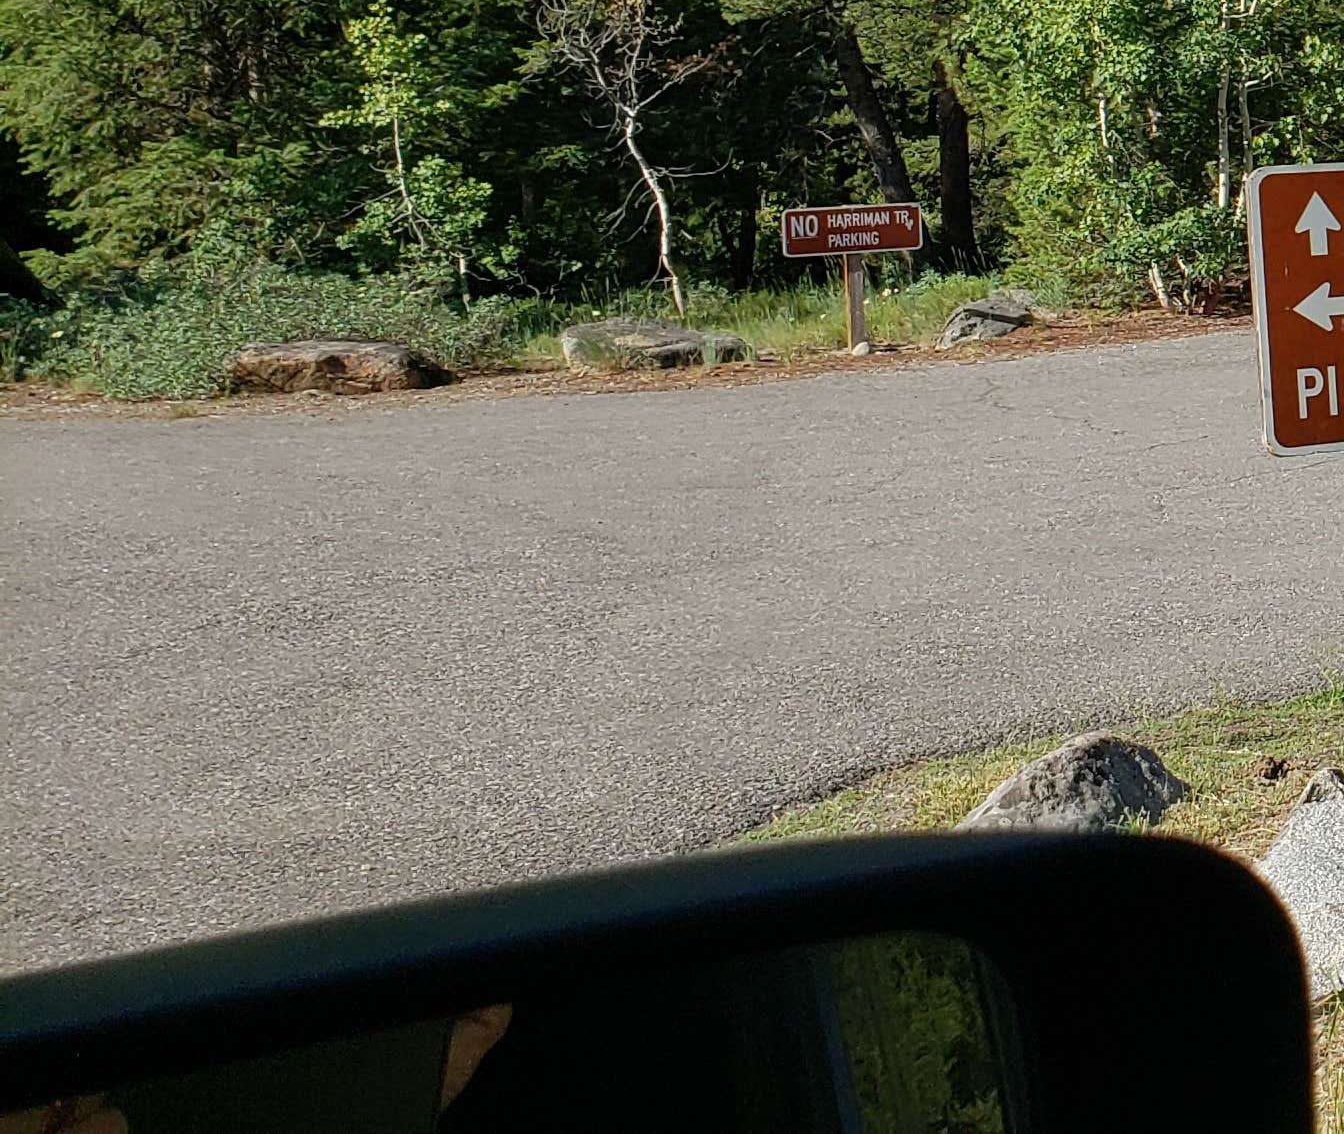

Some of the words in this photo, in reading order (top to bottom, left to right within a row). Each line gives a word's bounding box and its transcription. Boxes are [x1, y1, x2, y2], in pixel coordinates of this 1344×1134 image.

[790, 215, 819, 238] NO
[827, 211, 890, 229] HARRIMAN
[828, 232, 880, 248] PARKING
